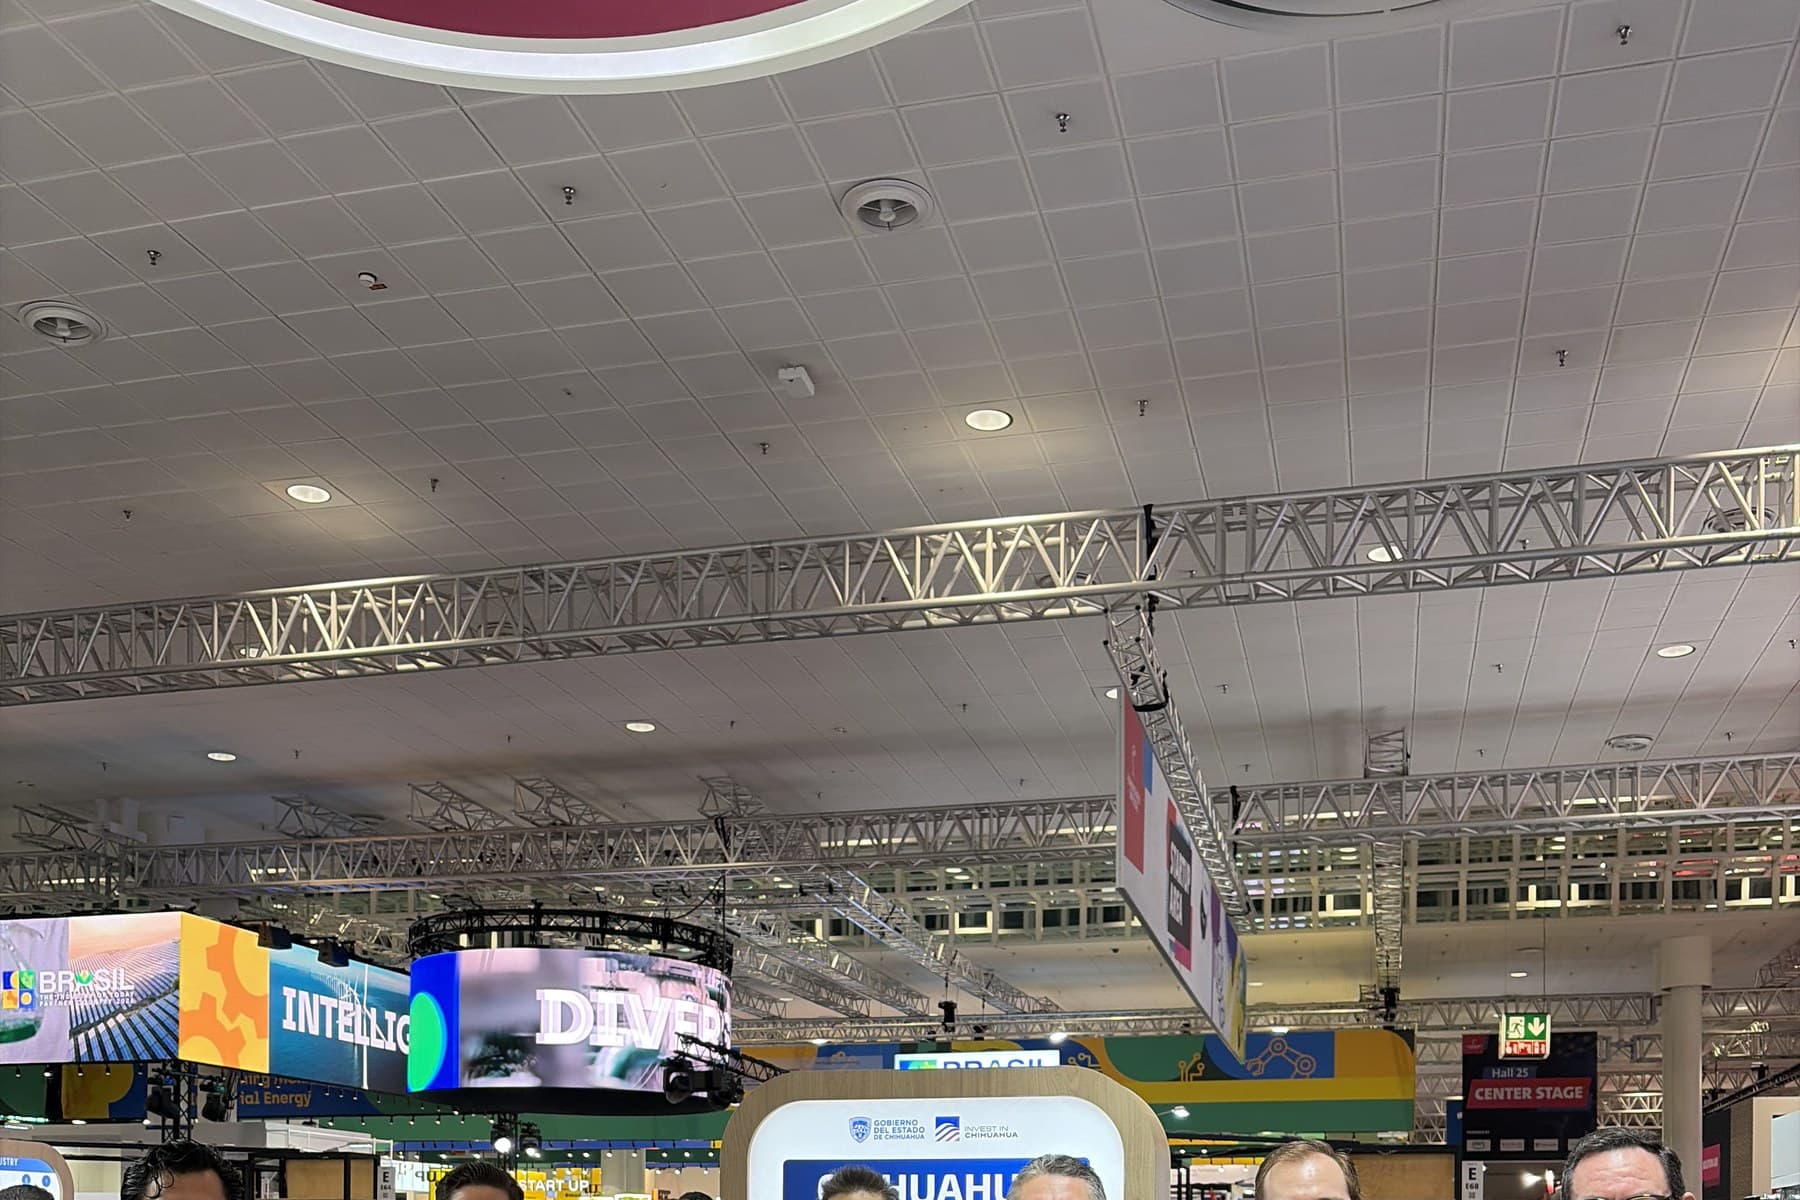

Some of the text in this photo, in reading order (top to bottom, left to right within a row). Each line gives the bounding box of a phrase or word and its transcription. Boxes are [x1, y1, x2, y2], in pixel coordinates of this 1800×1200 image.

[40, 968, 134, 993] BRASIL
[1492, 1067, 1528, 1078] Hall 25
[264, 1091, 312, 1107] Energy
[1475, 1087, 1583, 1100] CENTER STAGE
[873, 1119, 918, 1127] GOBIERNO
[873, 1126, 888, 1134] DEL
[383, 1171, 390, 1183] E
[1468, 1167, 1477, 1180] E
[519, 1179, 564, 1192] START
[568, 1179, 589, 1192] UP
